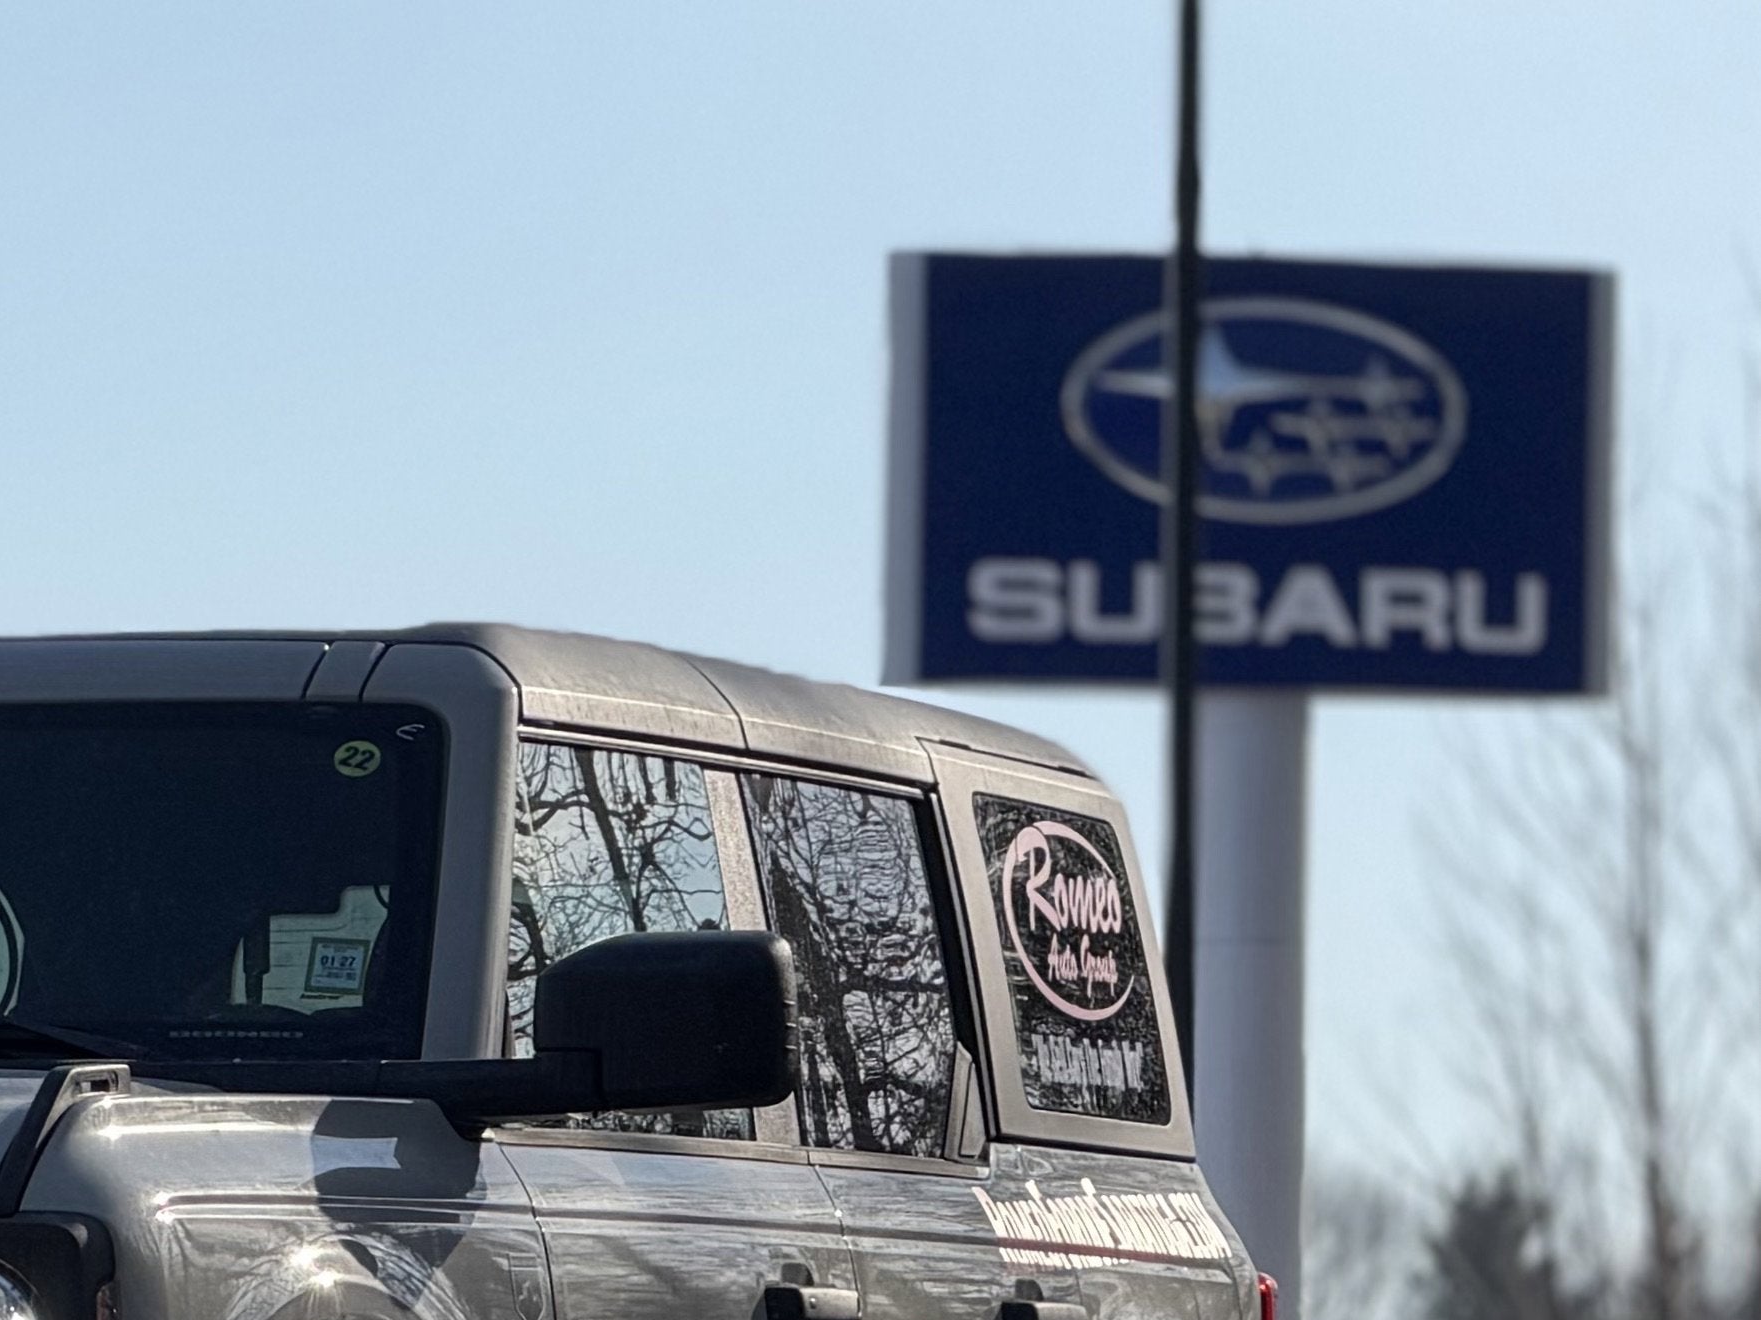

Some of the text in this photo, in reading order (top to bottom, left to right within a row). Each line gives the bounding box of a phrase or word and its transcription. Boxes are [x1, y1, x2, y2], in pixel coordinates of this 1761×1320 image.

[966, 556, 1549, 655] SUBARU
[338, 745, 376, 771] 22
[1015, 825, 1123, 934] Romeo
[1047, 932, 1118, 998] Auto Group
